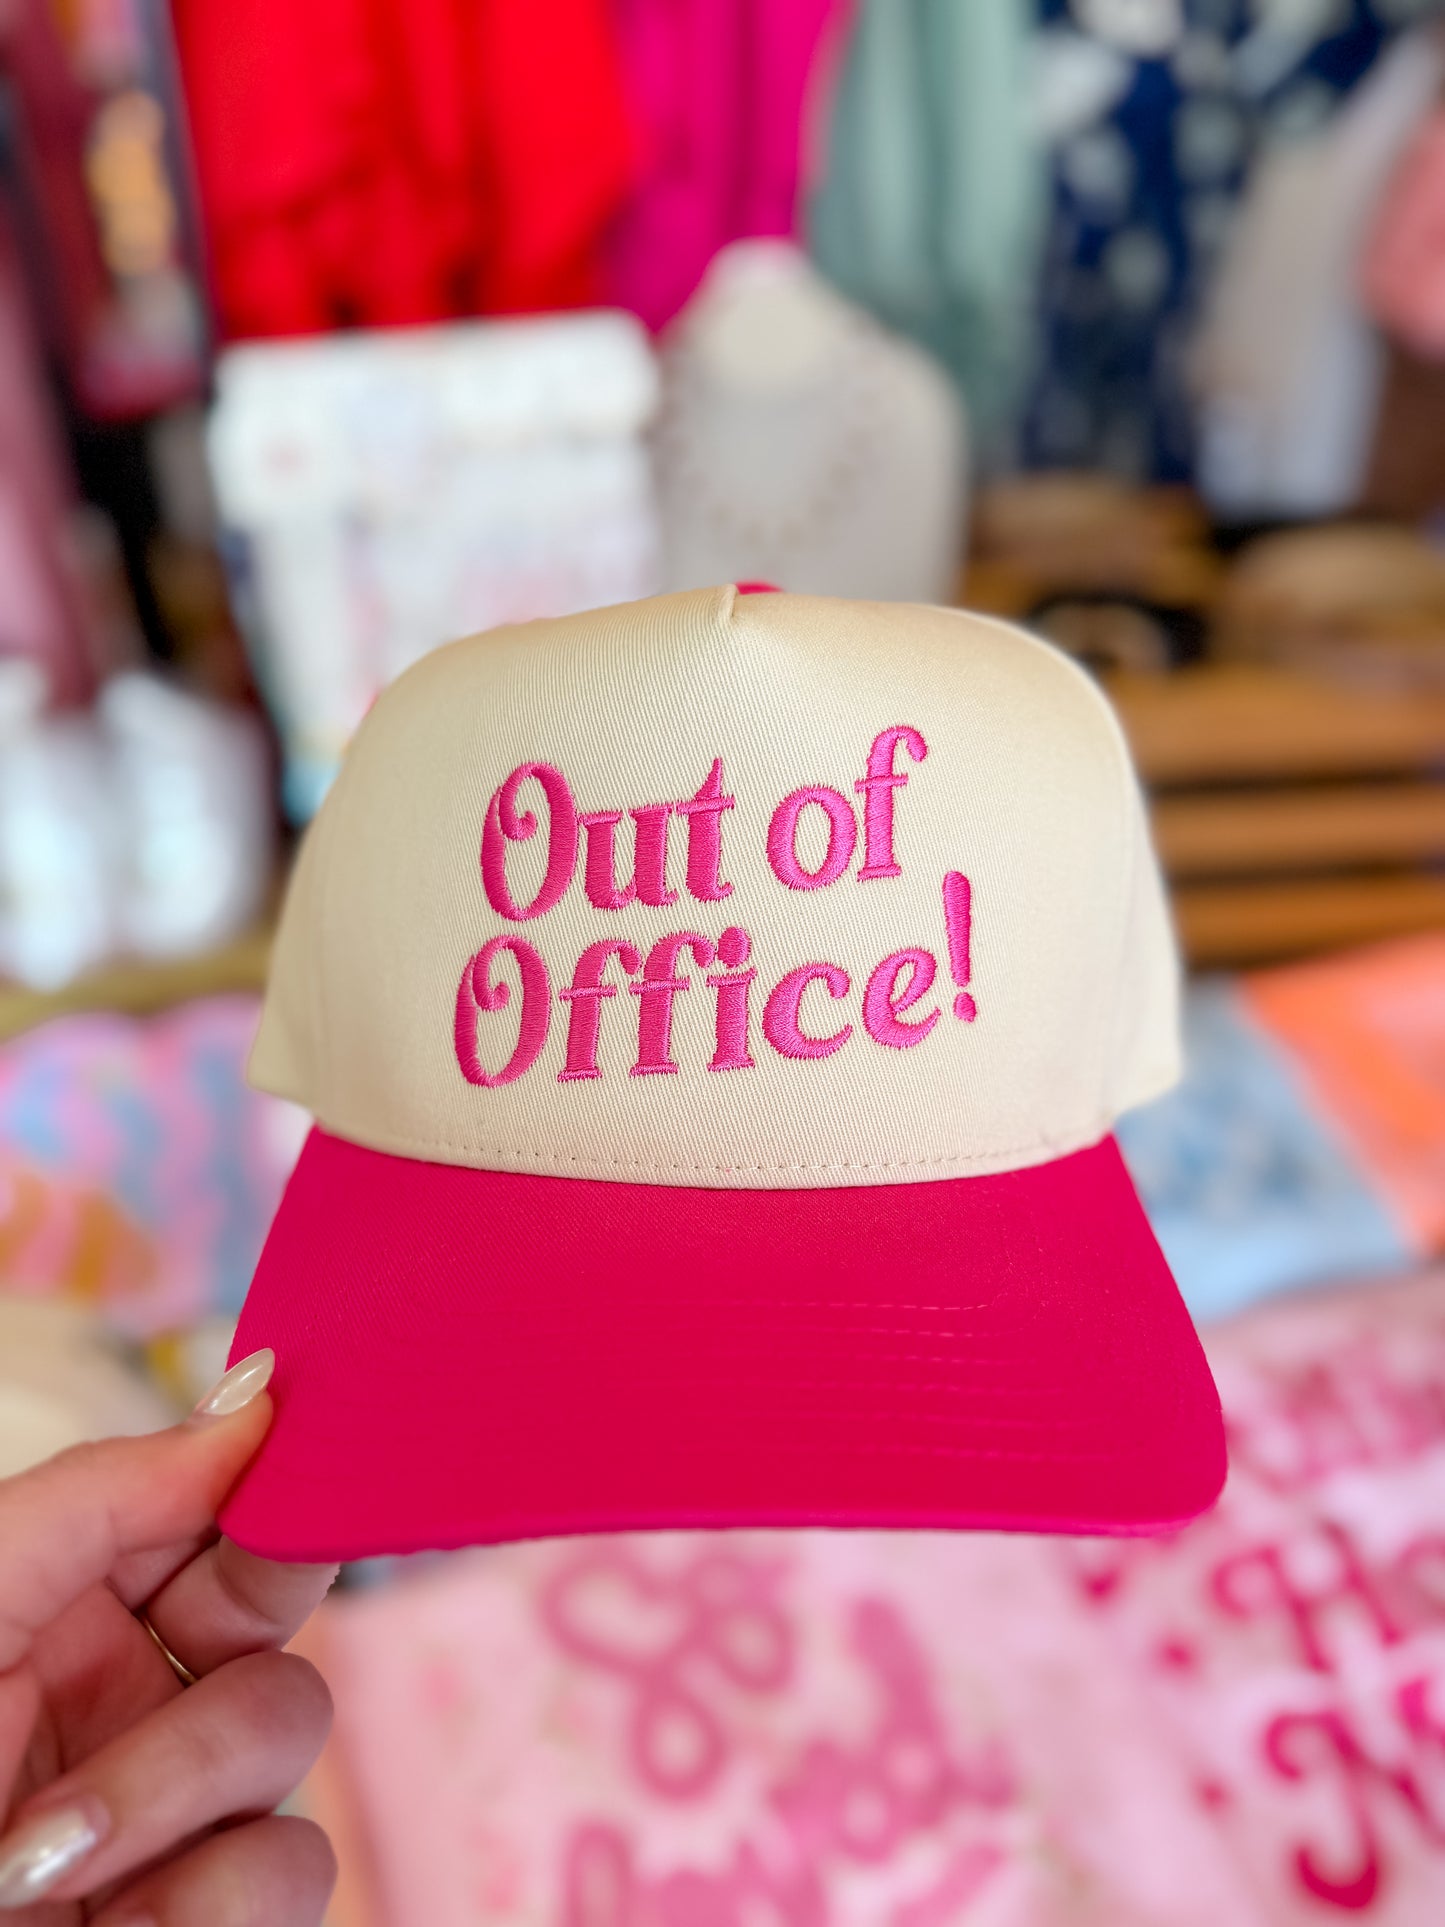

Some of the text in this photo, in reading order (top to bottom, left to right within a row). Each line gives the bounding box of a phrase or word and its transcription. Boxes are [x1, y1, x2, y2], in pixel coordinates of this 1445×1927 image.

[480, 724, 928, 922] Out of
[453, 870, 978, 1088] Office!
